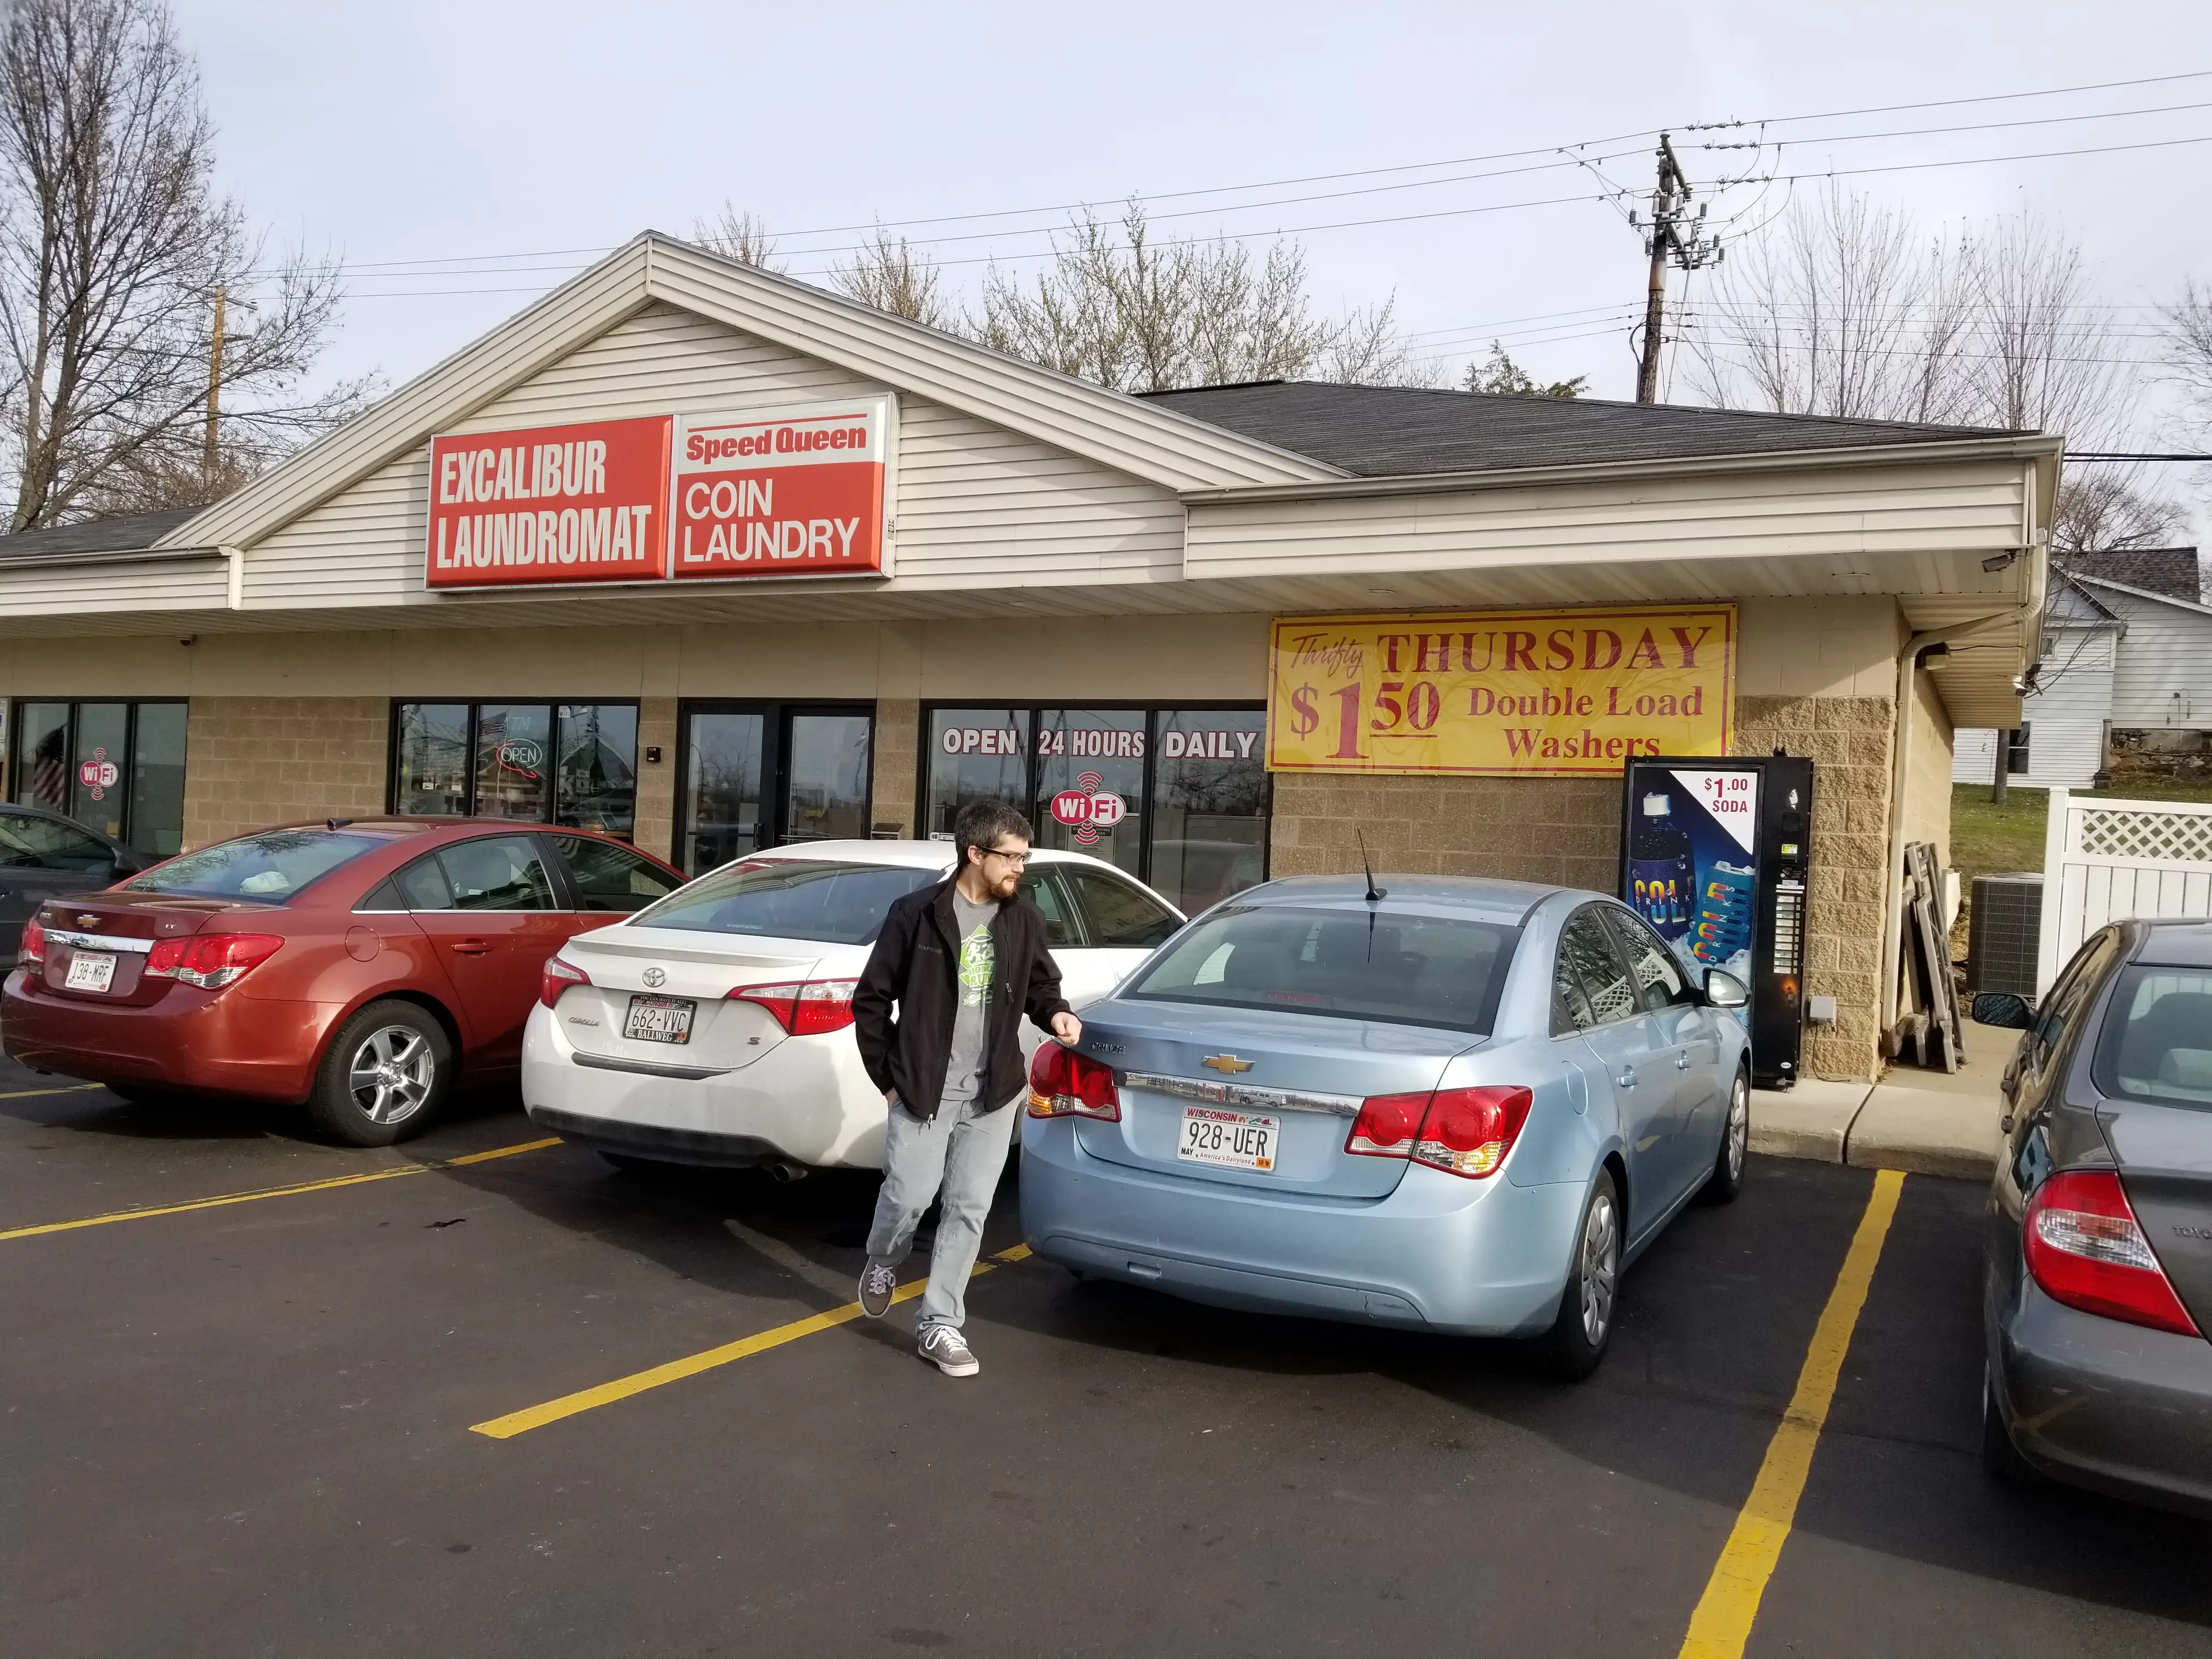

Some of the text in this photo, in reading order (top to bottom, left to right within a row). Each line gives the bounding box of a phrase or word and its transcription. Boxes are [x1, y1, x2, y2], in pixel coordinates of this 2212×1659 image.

[686, 426, 867, 465] Speed Queen
[439, 439, 606, 504] EXCALIBUR
[685, 478, 773, 520] COIN
[436, 505, 652, 568] LAUNDROMAT
[684, 517, 859, 562] LAUNDRY
[1291, 626, 1713, 679] Thrifty THURSDAY
[1468, 685, 1703, 717] Double Load
[500, 747, 537, 763] OPEN
[942, 727, 1259, 759] OPEN 24 HOURS DAILY
[1503, 727, 1661, 759] Washers
[1704, 777, 1748, 798] $1.00
[1712, 799, 1748, 813] SODA
[72, 962, 110, 983] 138-MRF
[632, 1008, 687, 1032] 662-VVC
[636, 1029, 673, 1042] BALLWEG
[1187, 1108, 1238, 1122] WISCONSIN
[1181, 1147, 1194, 1156] MAY
[1189, 1121, 1268, 1157] 928-UER
[1199, 1152, 1251, 1165] America's Dairyland
